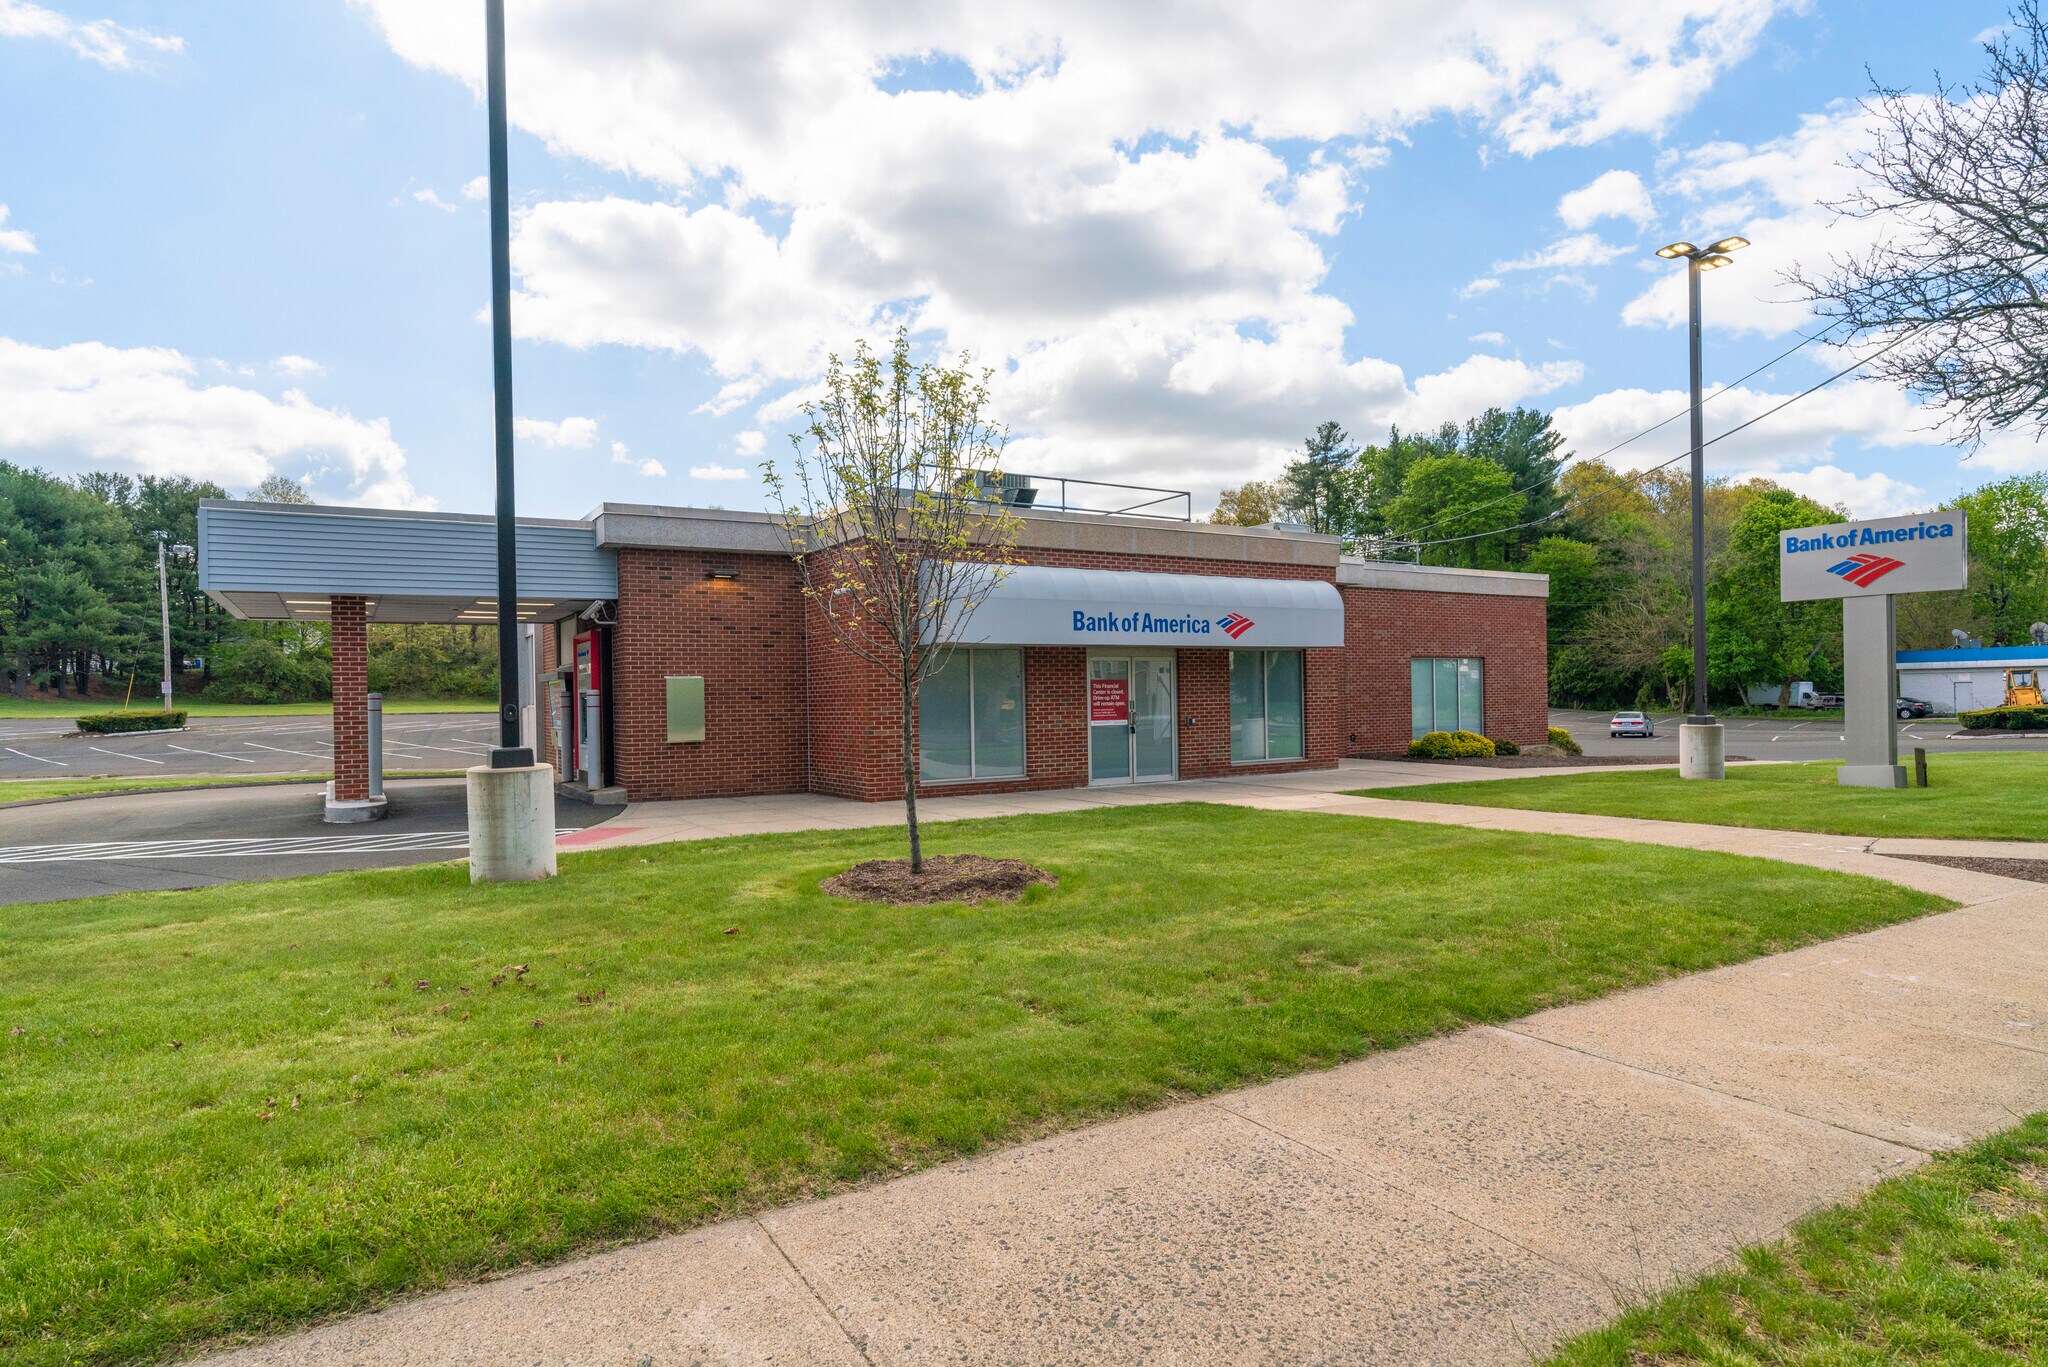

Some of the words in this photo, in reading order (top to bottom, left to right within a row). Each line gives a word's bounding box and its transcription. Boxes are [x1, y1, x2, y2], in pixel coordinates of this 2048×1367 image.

[1786, 532, 1834, 553] Bank
[1837, 529, 1857, 548] of
[1860, 522, 1953, 545] America
[1073, 610, 1119, 632] Bank
[1122, 612, 1139, 632] of
[1142, 612, 1210, 634] America
